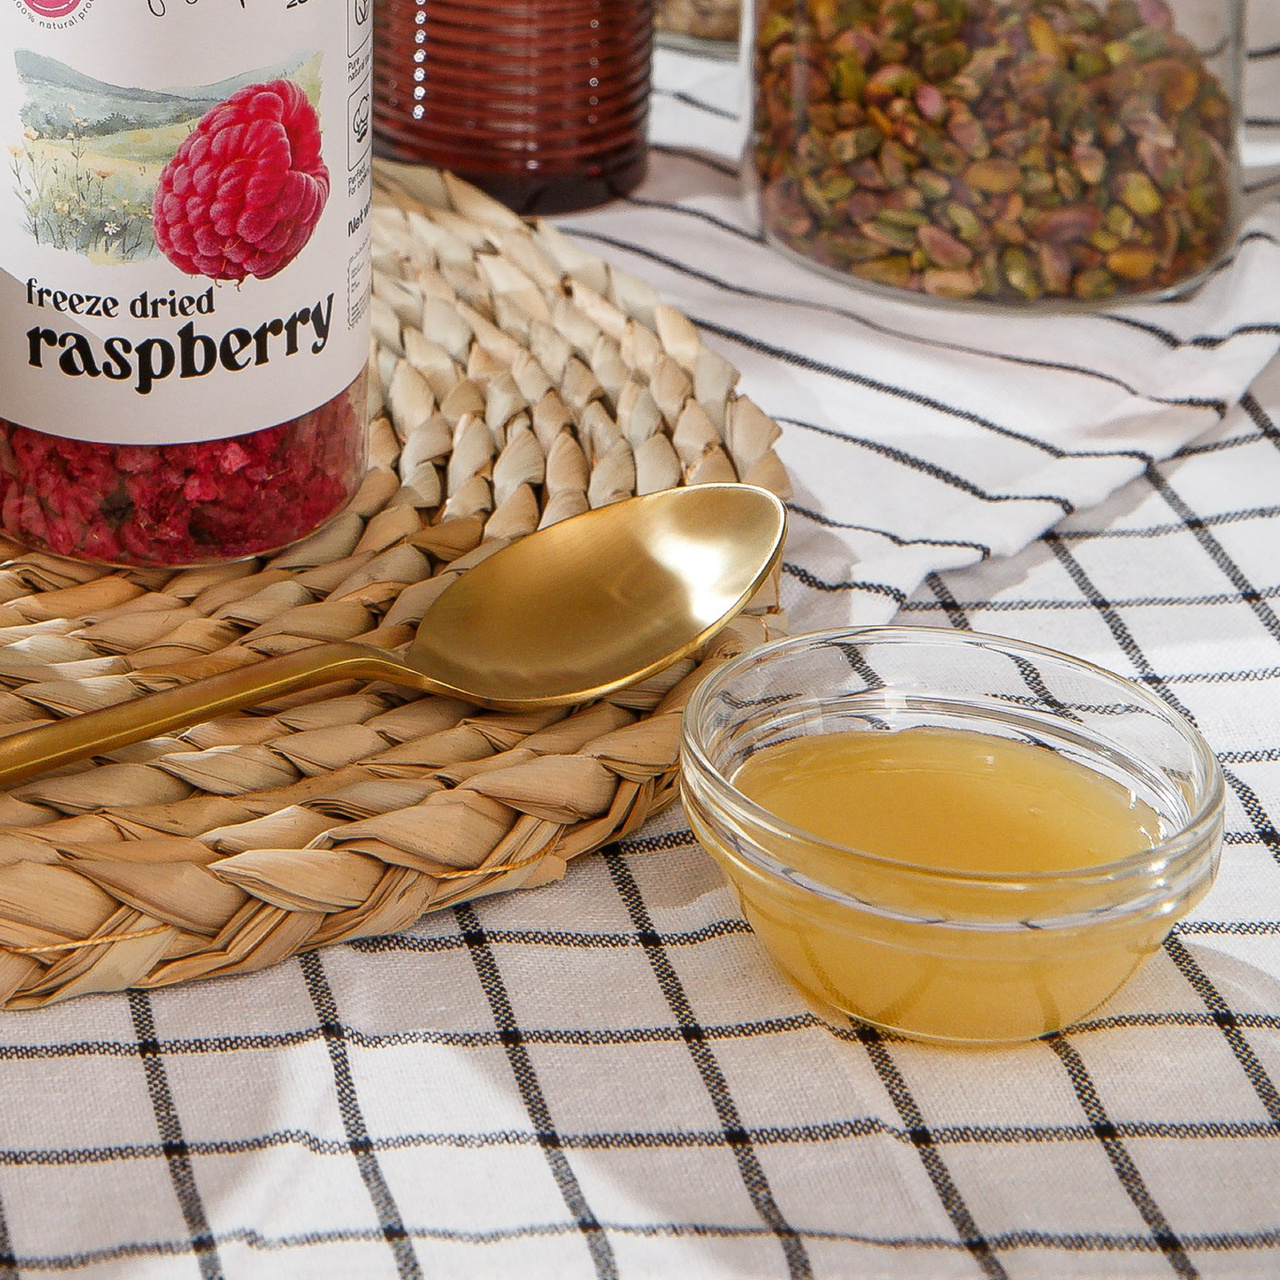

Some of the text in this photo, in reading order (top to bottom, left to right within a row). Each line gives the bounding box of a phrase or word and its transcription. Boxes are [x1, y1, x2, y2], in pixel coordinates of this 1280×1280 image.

[39, 16, 78, 30] natural
[348, 209, 363, 237] Net
[26, 278, 216, 319] freeze dried
[26, 292, 335, 395] raspberry
